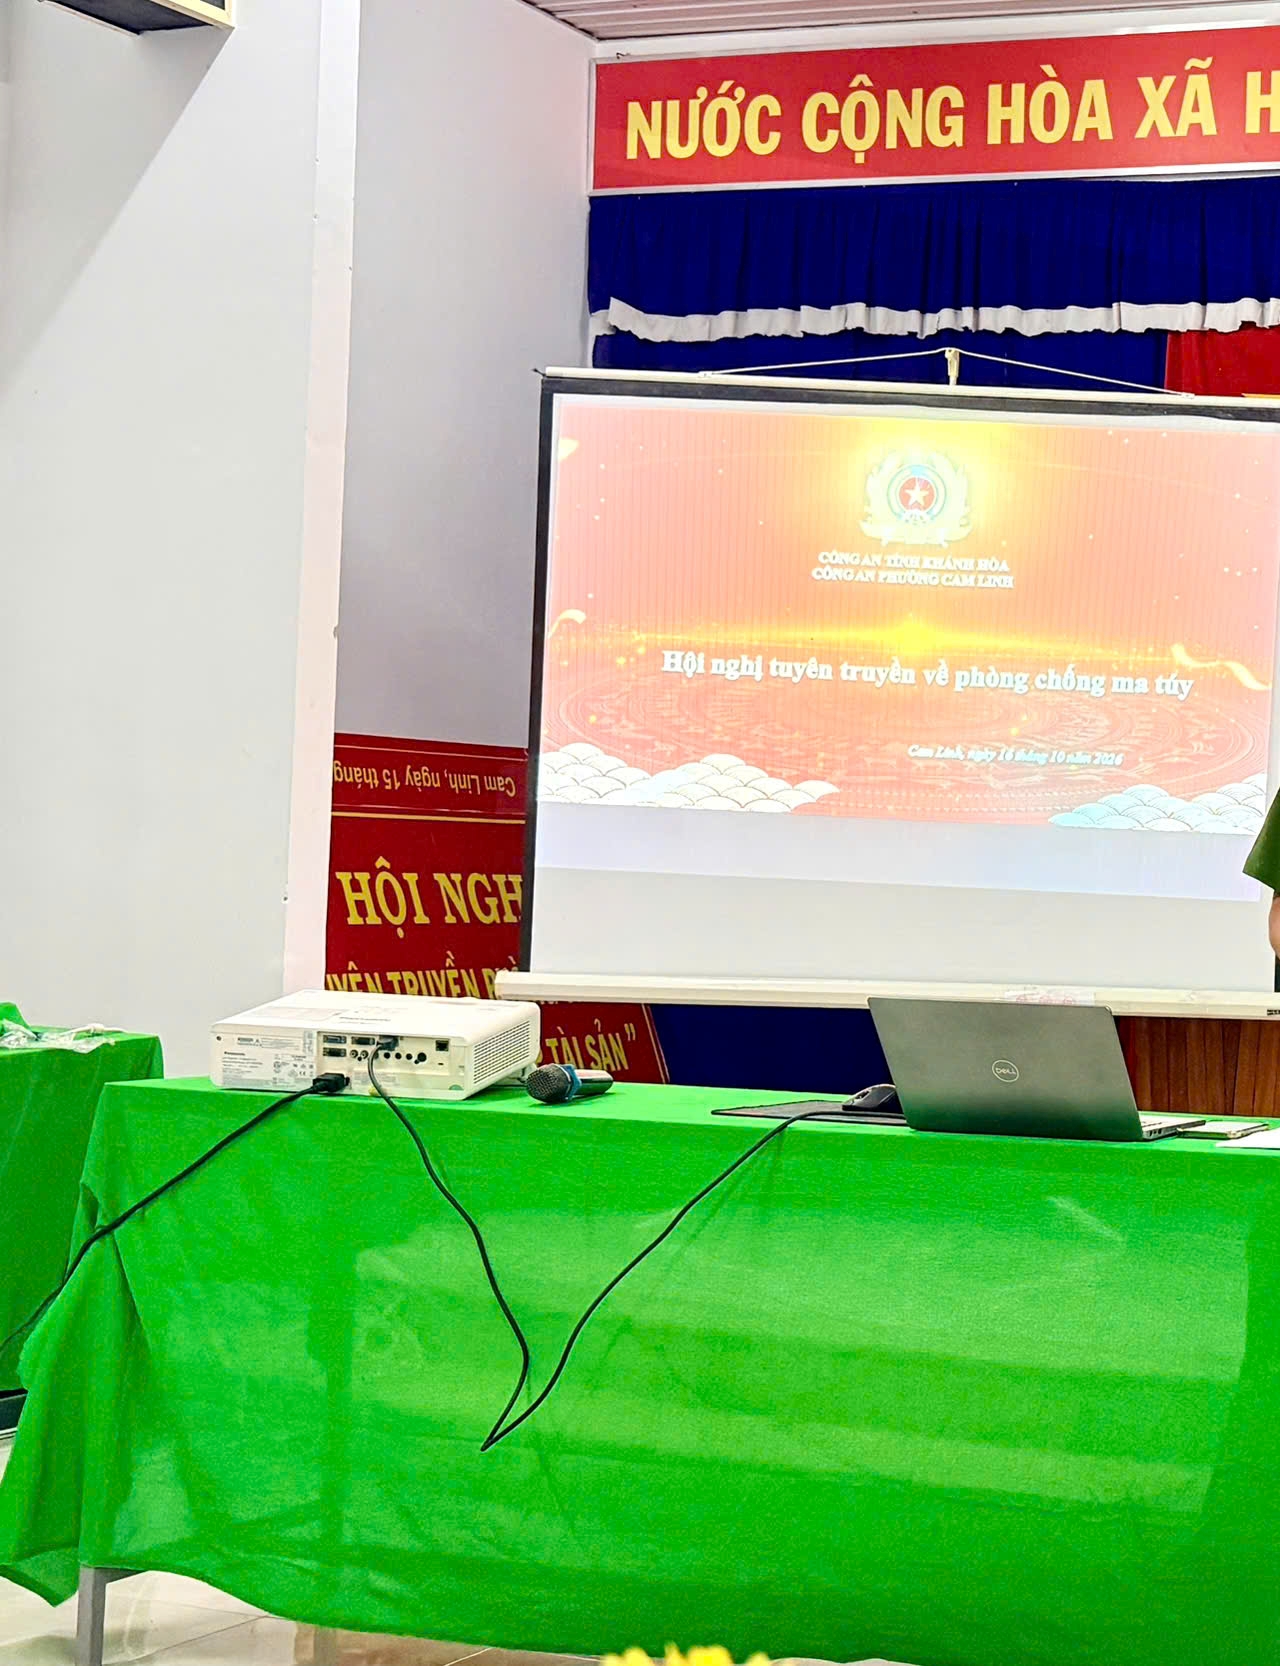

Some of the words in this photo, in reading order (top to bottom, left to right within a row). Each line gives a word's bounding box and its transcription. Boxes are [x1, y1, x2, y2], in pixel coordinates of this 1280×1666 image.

[626, 79, 782, 160] NƯỚC
[802, 72, 965, 164] CỘNG
[986, 64, 1114, 145] HÒA
[1135, 56, 1217, 138] XÃ
[661, 649, 705, 678] Hội
[710, 654, 763, 683] nghị
[769, 656, 833, 684] tuyên
[839, 655, 916, 688] truyền
[922, 658, 949, 686] về
[953, 664, 1029, 694] phòng
[1034, 663, 1105, 697] chống
[1111, 675, 1149, 694] ma
[1154, 671, 1194, 701] túy
[333, 760, 379, 790] tháng
[382, 768, 401, 791] 15
[405, 764, 441, 793] ngày
[444, 768, 481, 795] Linh,
[484, 775, 516, 798] Cam
[335, 855, 430, 939] HỘI
[433, 872, 523, 924] NGH
[545, 1026, 585, 1070] TÀI
